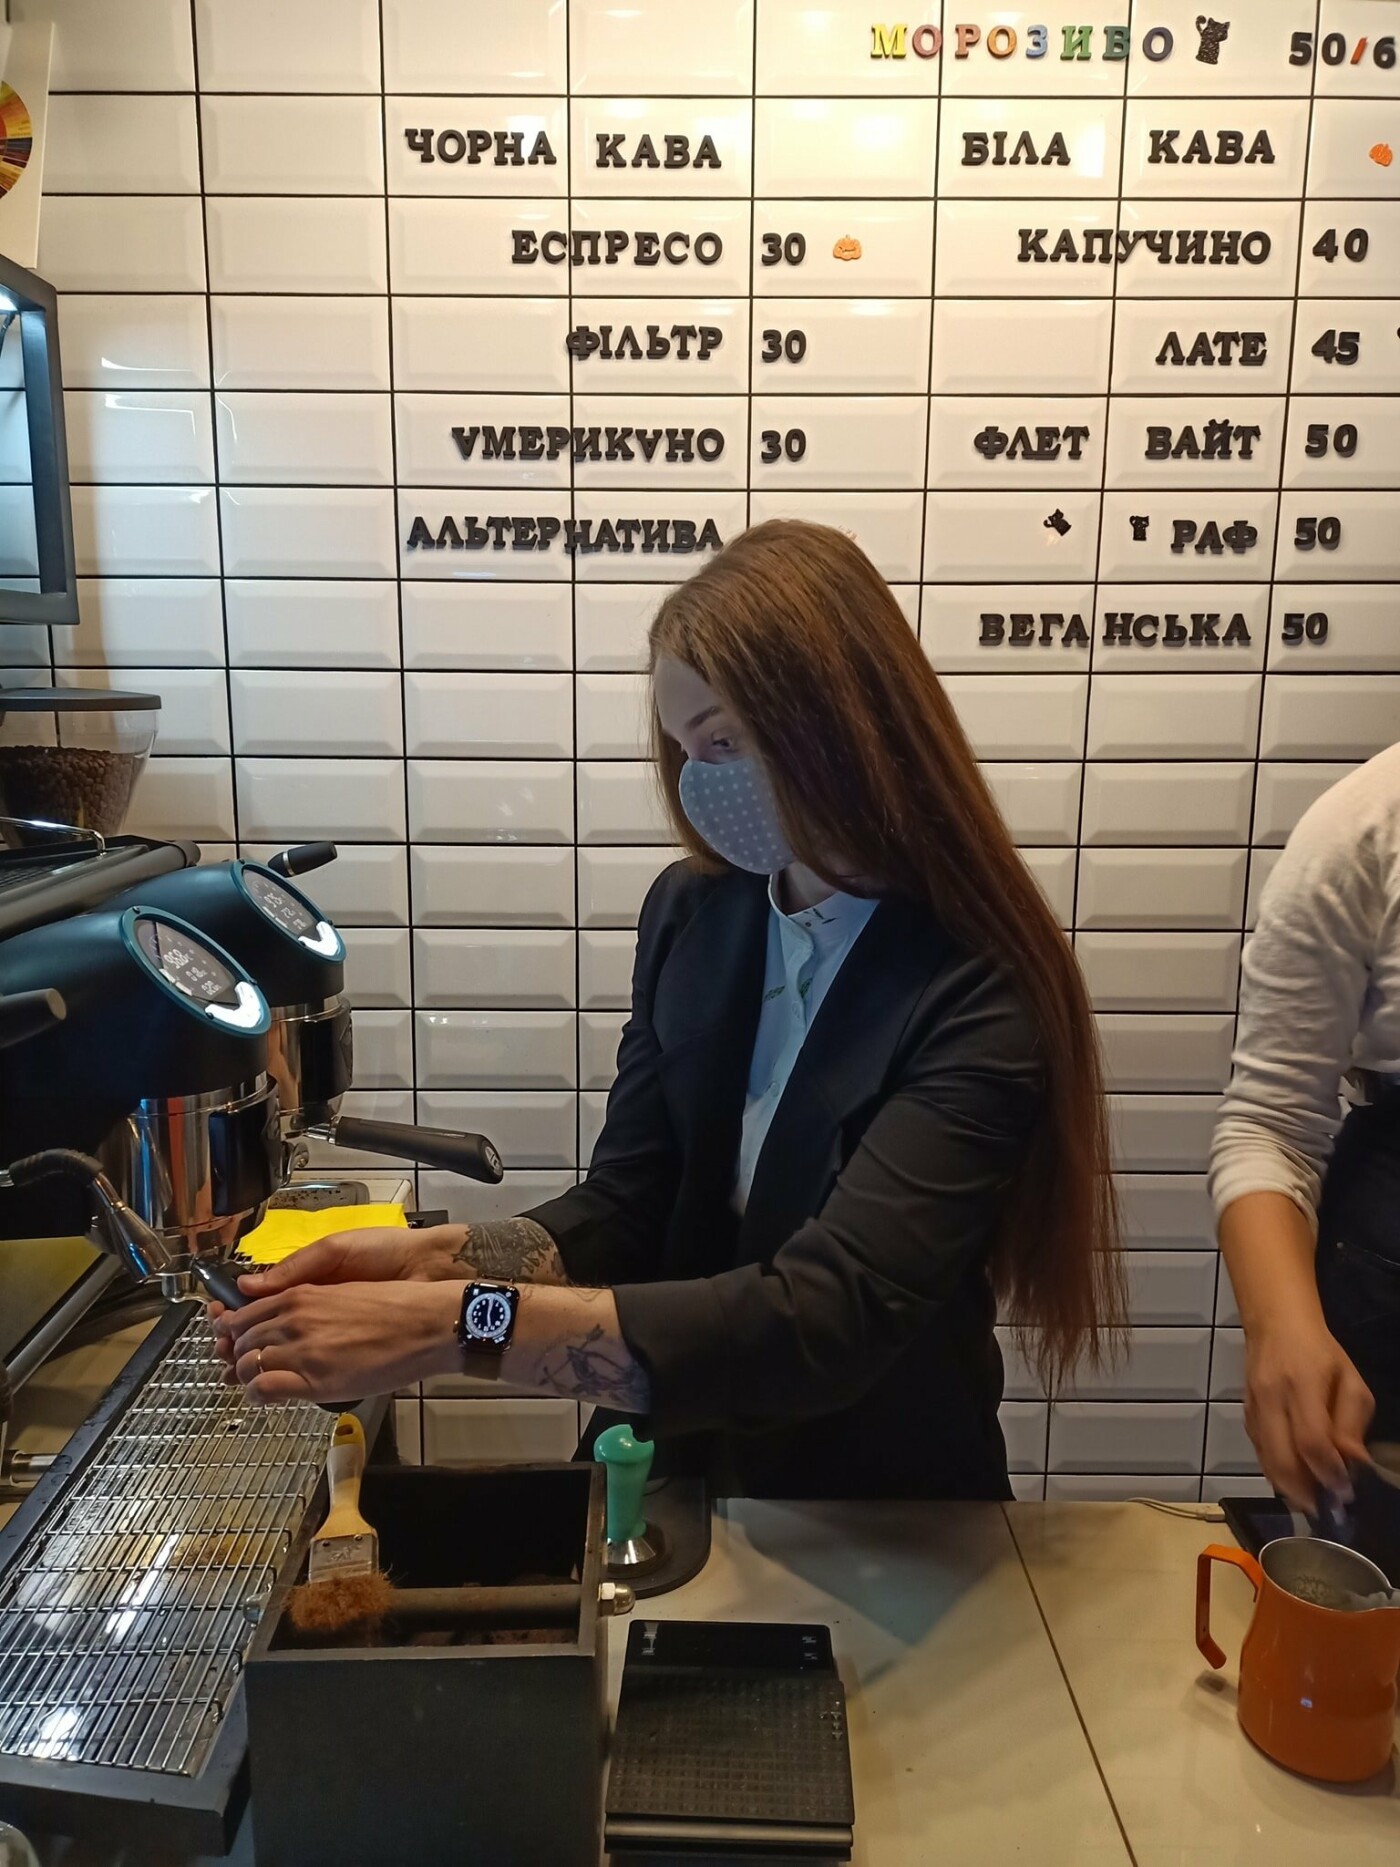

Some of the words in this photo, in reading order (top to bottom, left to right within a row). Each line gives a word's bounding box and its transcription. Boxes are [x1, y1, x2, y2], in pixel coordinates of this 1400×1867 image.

[871, 24, 1174, 62] МОРОЗИВО
[404, 128, 557, 166] ЧОРНА
[596, 133, 722, 169] КАВА
[961, 131, 1071, 166] БІЛА
[1148, 129, 1276, 165] КАВА
[511, 229, 723, 267] ЕСПРЕСО
[761, 232, 807, 267] 30
[1017, 228, 1271, 265] КАПУЧИНО
[1312, 228, 1370, 263] 40
[566, 325, 724, 362] ФІЛЬТР
[761, 329, 807, 363] 30
[1155, 331, 1268, 366] ЛАТЕ
[1311, 329, 1361, 366] 45
[760, 429, 807, 463] 30
[974, 425, 1091, 460] ФЛЕТ
[1144, 418, 1262, 460] ВАЙТ
[1304, 424, 1359, 458] 50
[406, 516, 724, 554] АЛЬТЕРНАТИВА
[1171, 519, 1259, 554] РАФ
[1294, 516, 1342, 551] 50
[1281, 612, 1330, 646] 50
